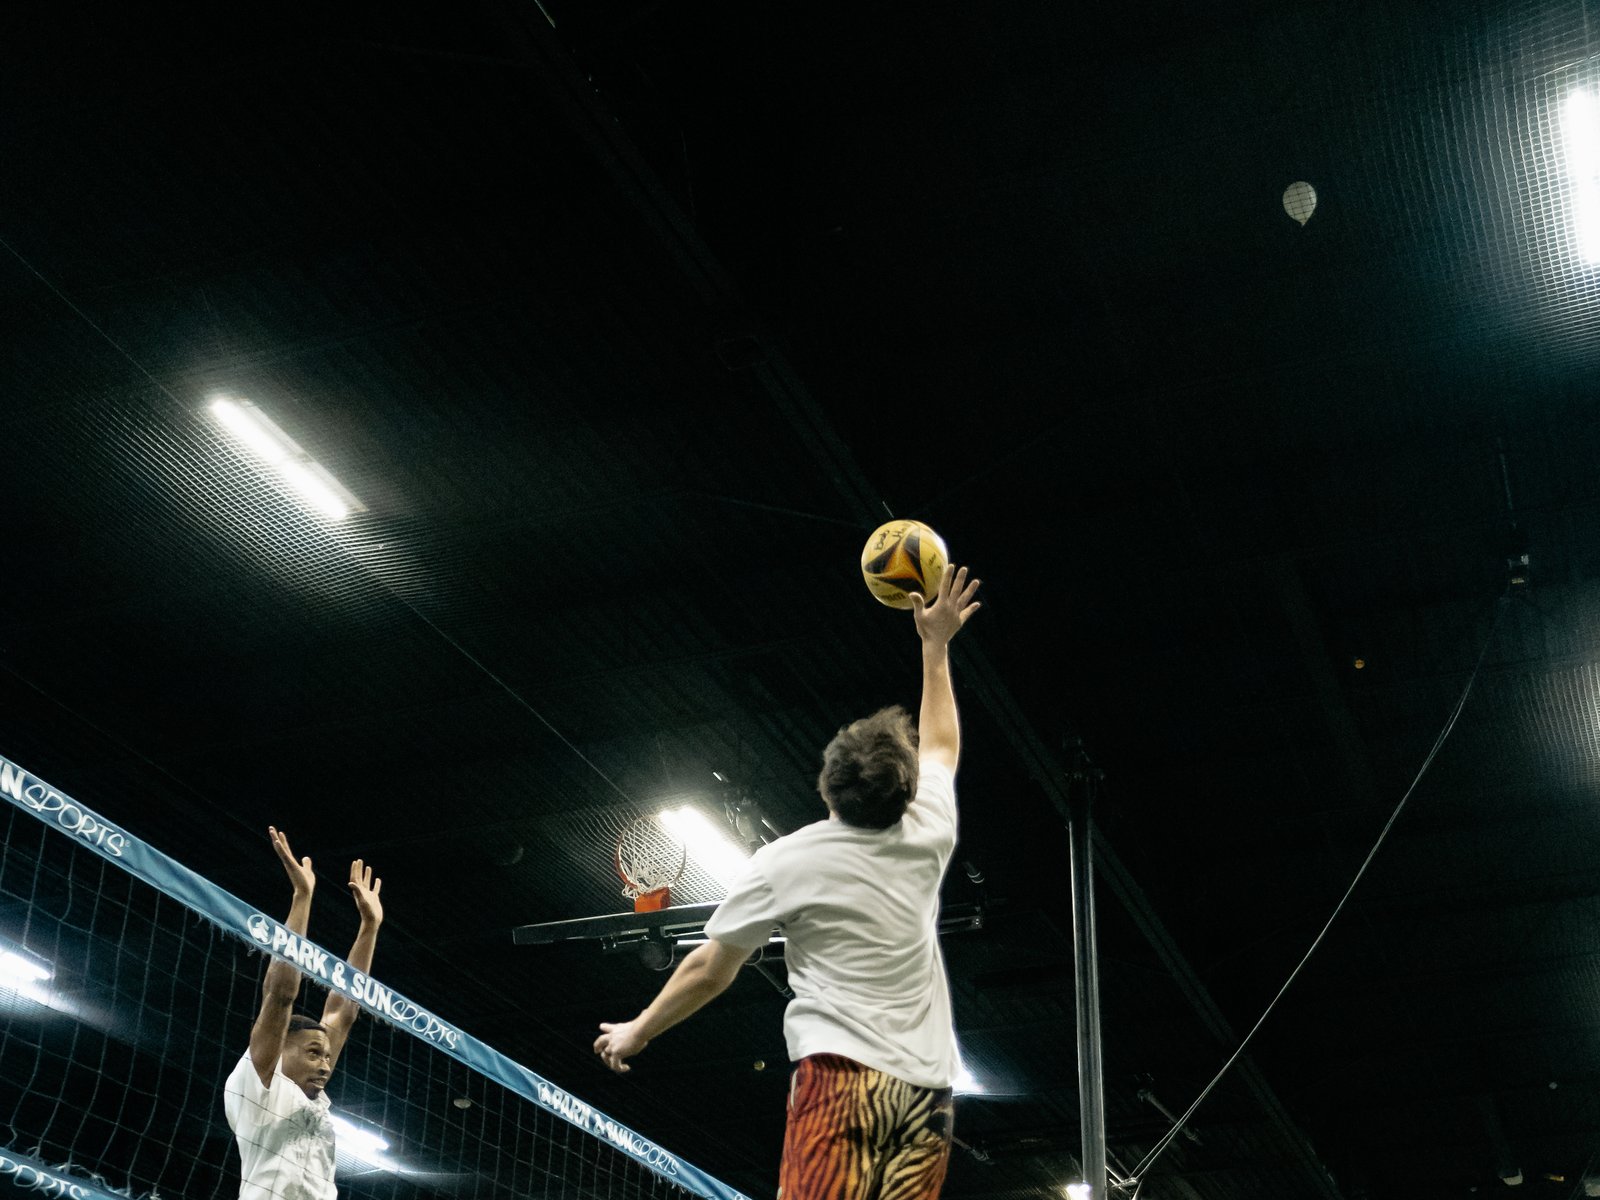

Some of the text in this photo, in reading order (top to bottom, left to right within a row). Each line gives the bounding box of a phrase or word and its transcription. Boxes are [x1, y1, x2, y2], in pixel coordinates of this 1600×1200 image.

[22, 784, 125, 857] SPORTS
[272, 925, 328, 979] PARK
[331, 962, 347, 991] &
